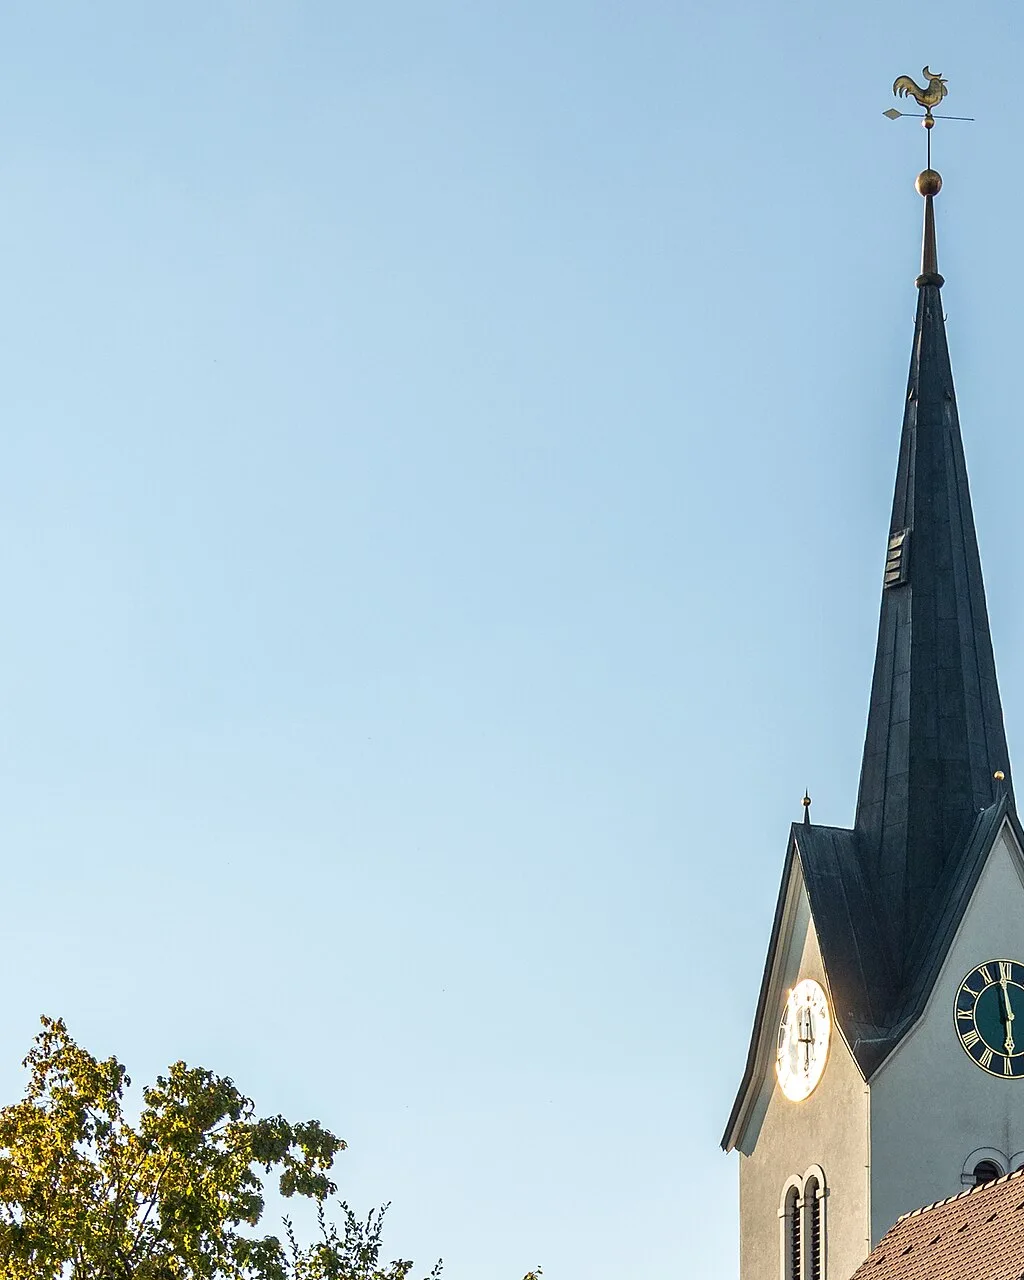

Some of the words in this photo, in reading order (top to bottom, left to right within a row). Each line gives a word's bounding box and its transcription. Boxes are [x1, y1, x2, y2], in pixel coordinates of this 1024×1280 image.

[978, 966, 992, 984] XI
[963, 984, 978, 998] X
[958, 1009, 972, 1019] IX
[979, 1049, 993, 1068] VII
[1004, 1057, 1013, 1075] VI
